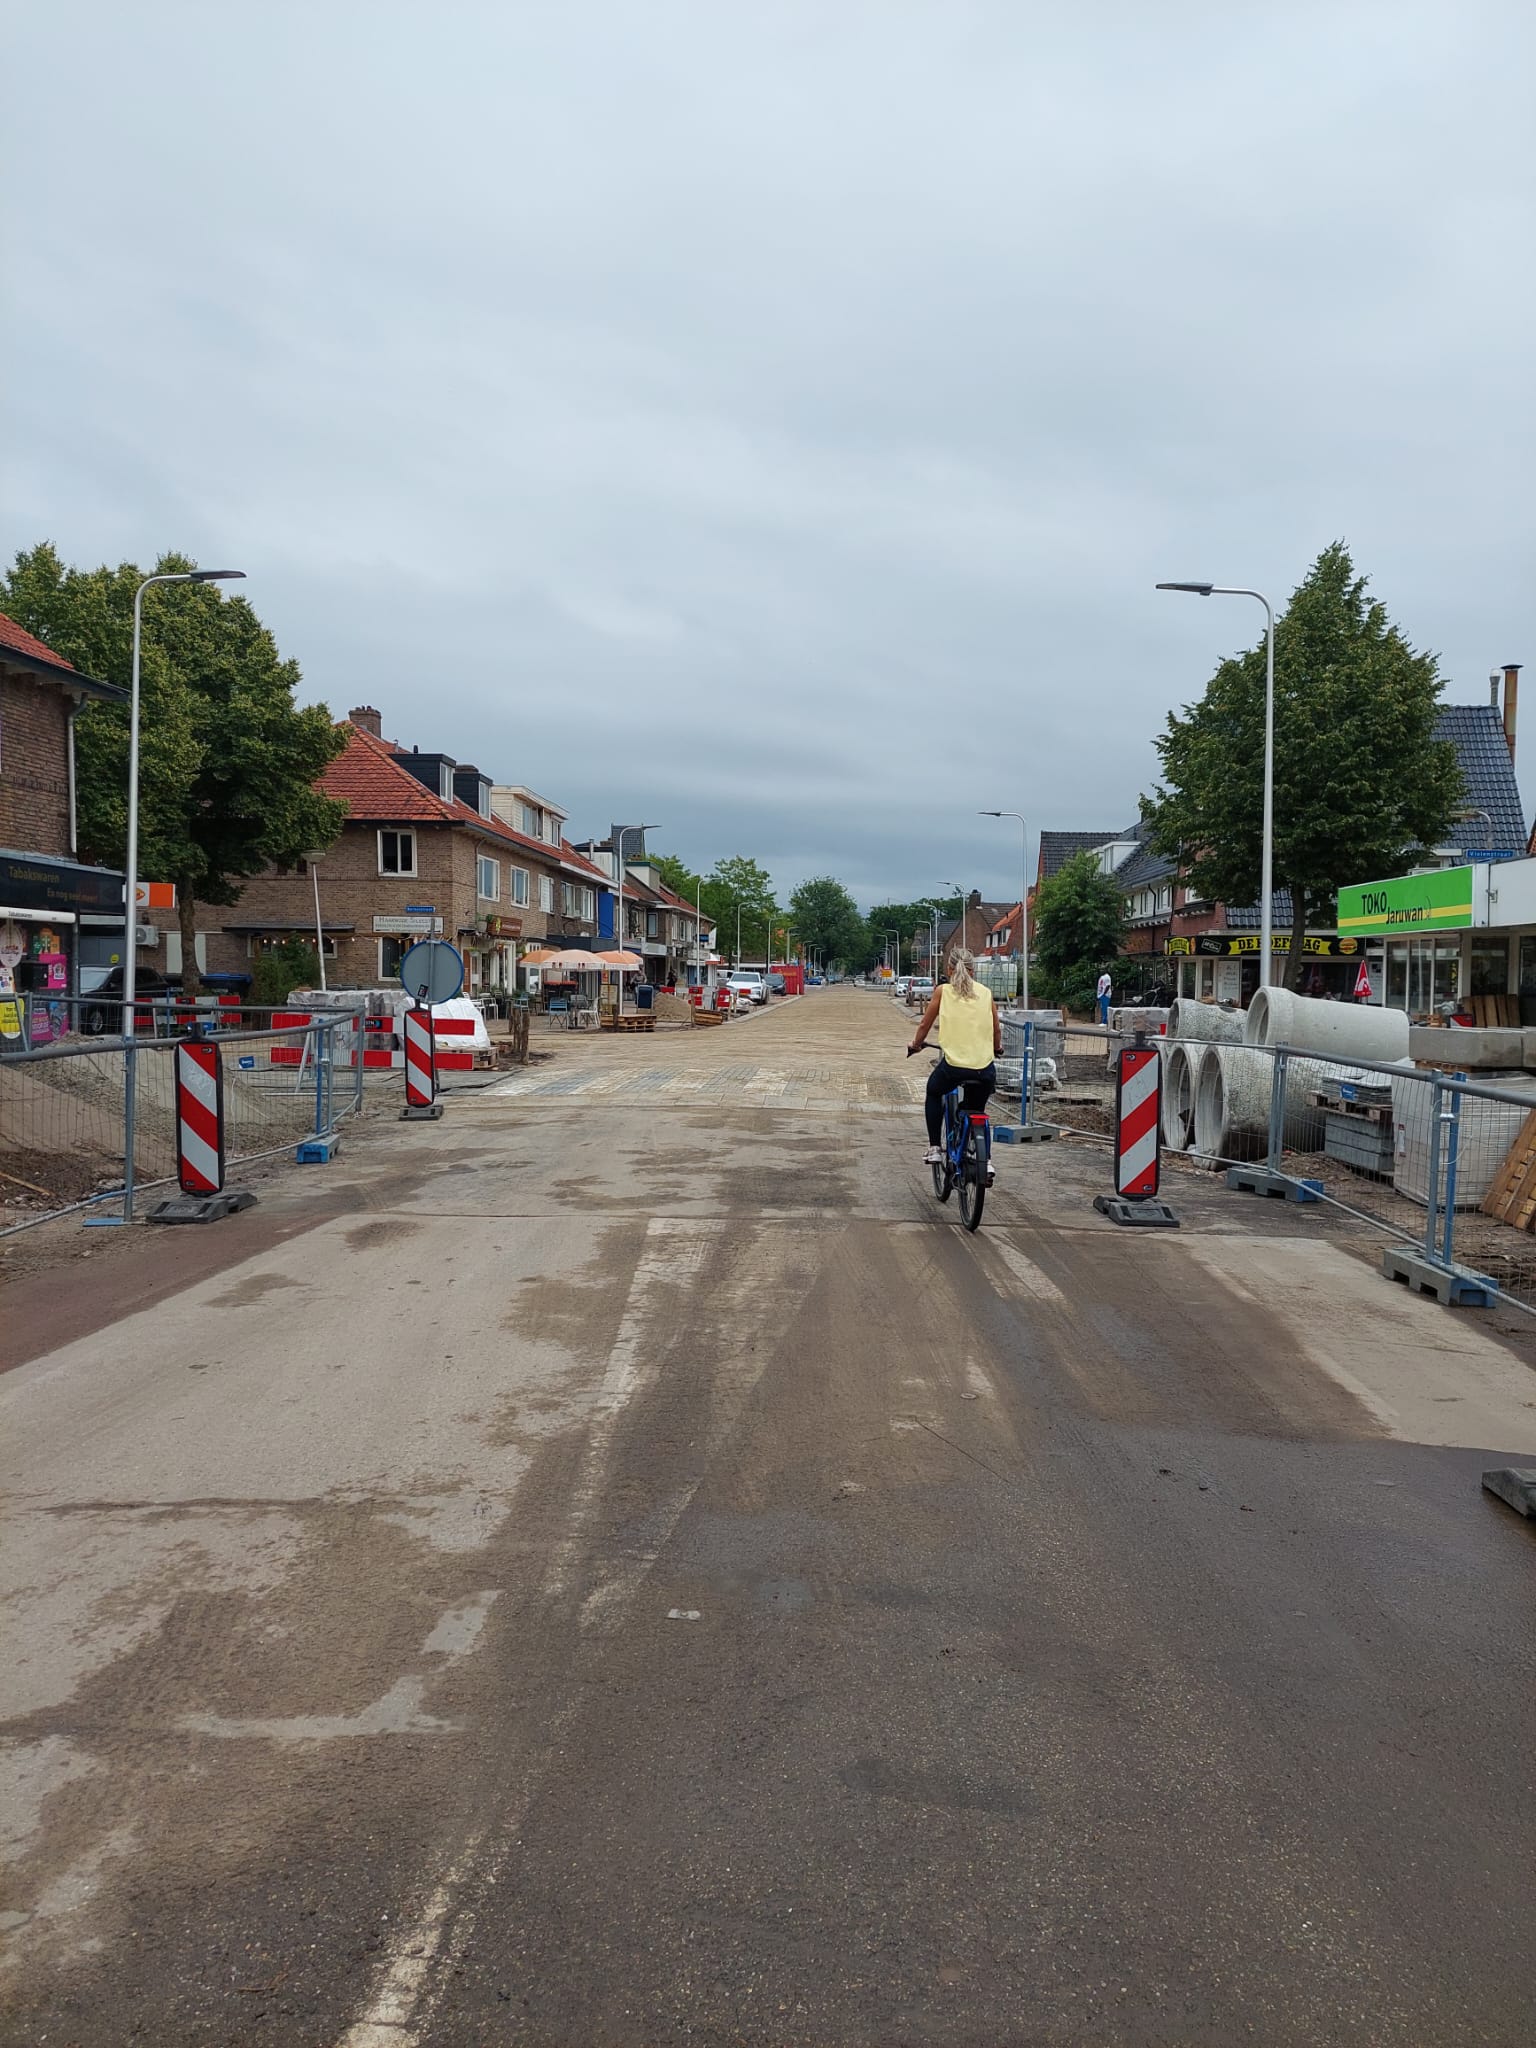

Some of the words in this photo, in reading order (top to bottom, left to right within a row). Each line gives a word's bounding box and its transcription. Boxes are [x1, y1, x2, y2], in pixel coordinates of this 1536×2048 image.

[8, 866, 60, 883] Tabakswaren
[1361, 891, 1387, 915] TOKO
[1386, 906, 1423, 925] Jaruwan
[1238, 939, 1254, 950] DE
